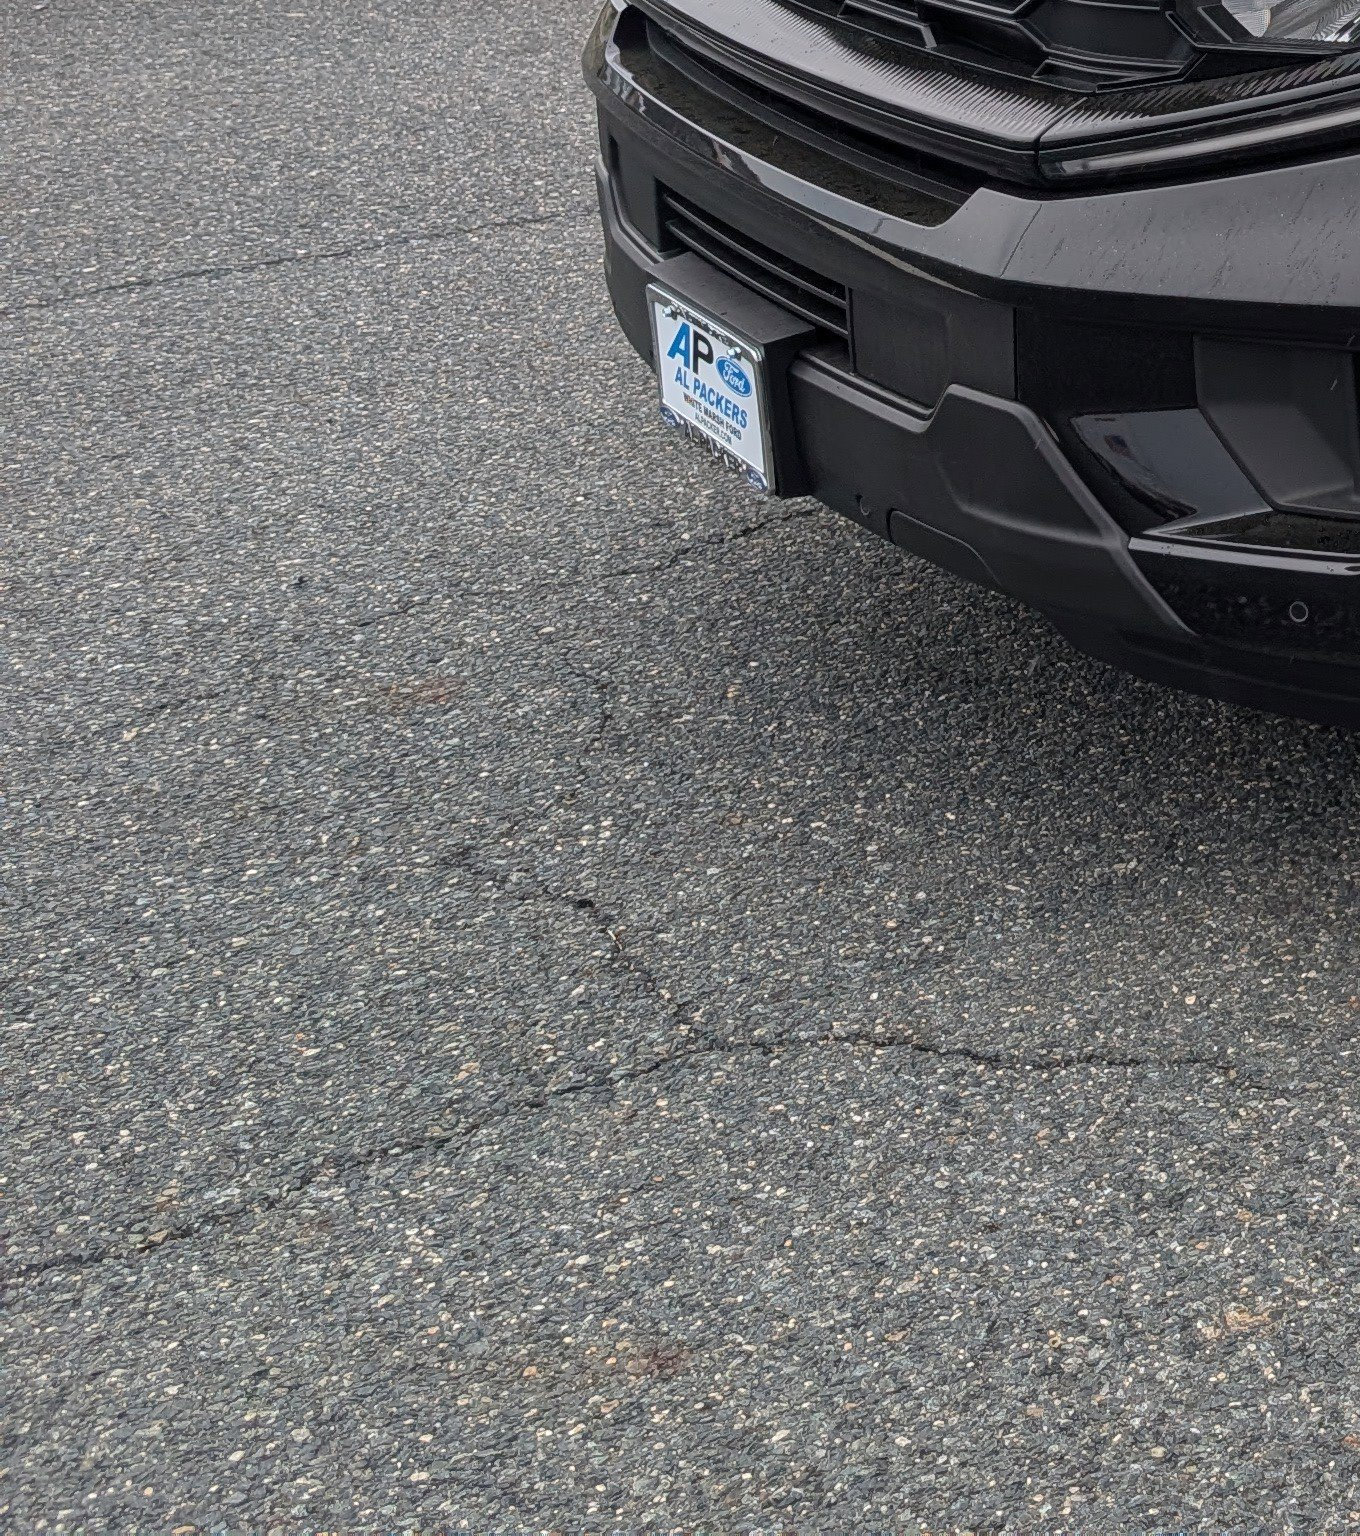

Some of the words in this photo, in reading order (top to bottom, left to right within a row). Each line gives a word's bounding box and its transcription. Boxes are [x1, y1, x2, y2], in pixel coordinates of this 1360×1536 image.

[667, 322, 714, 375] AP
[721, 361, 746, 393] Ford
[675, 366, 689, 390] AL
[693, 377, 748, 429] PACKERS
[726, 421, 742, 441] FORD
